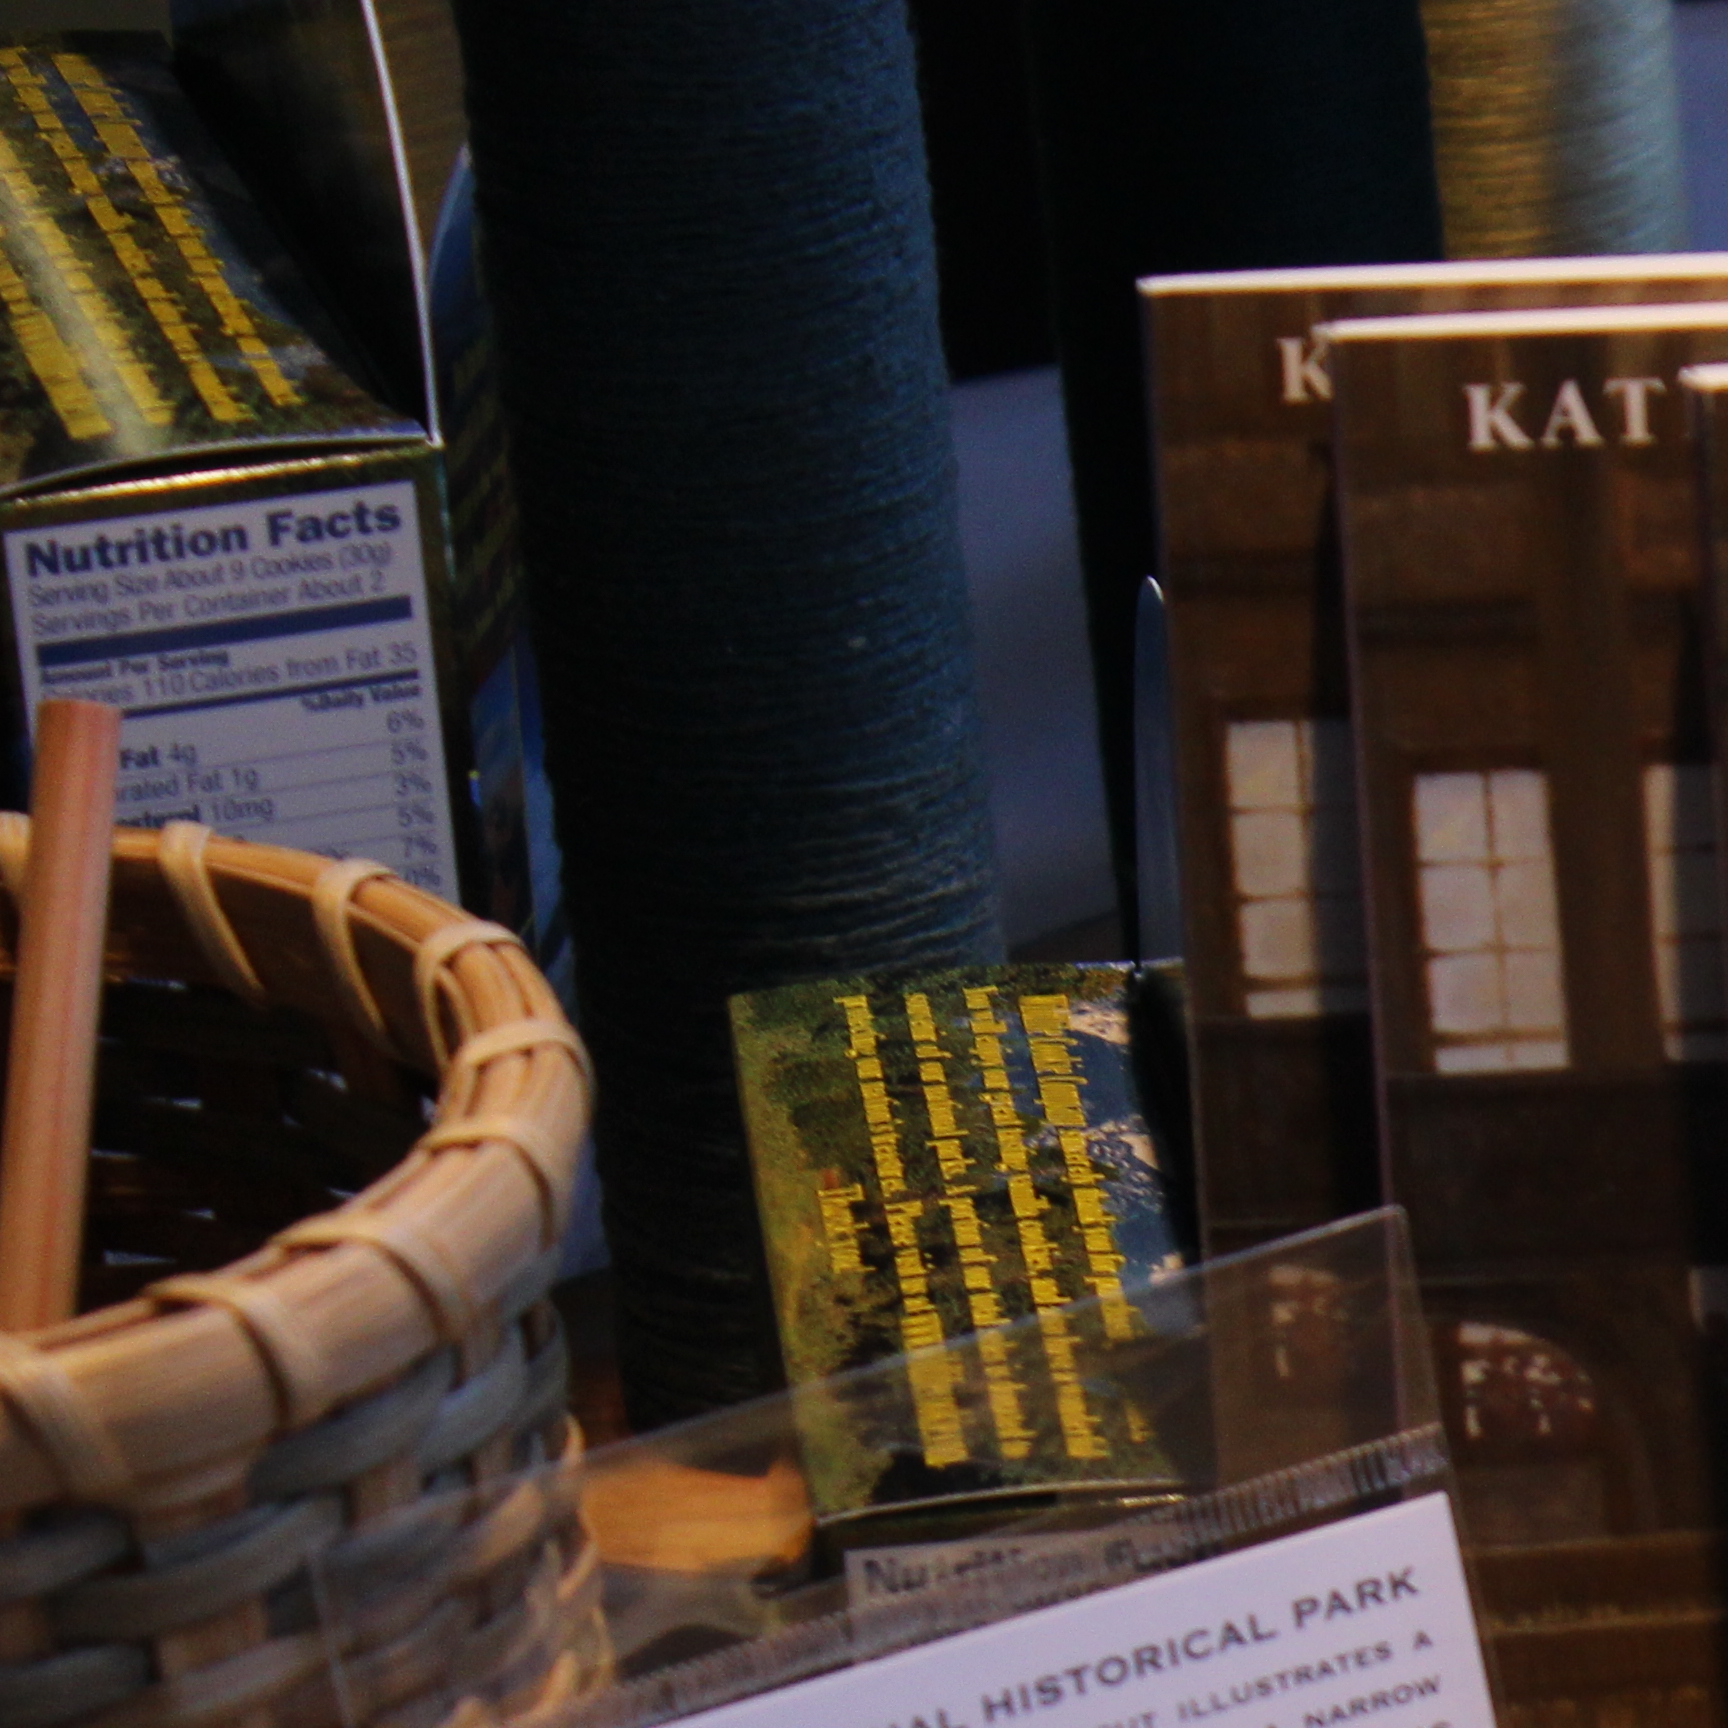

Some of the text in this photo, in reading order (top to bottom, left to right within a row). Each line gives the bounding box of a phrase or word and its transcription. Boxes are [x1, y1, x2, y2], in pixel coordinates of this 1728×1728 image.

[26, 501, 400, 577] Nutrition Facts
[27, 577, 108, 609] Serving
[115, 570, 158, 597] Size
[167, 562, 224, 591] About
[233, 558, 246, 581] 9
[251, 549, 332, 580] Cookies
[31, 570, 386, 636] Servings Per Container About 2
[346, 647, 380, 671] Fat
[981, 1612, 1280, 1725] HISTORICAL
[1294, 1567, 1420, 1628] PARK
[1178, 1642, 1393, 1724] ILLUSTRATES
[1412, 1629, 1434, 1651] A
